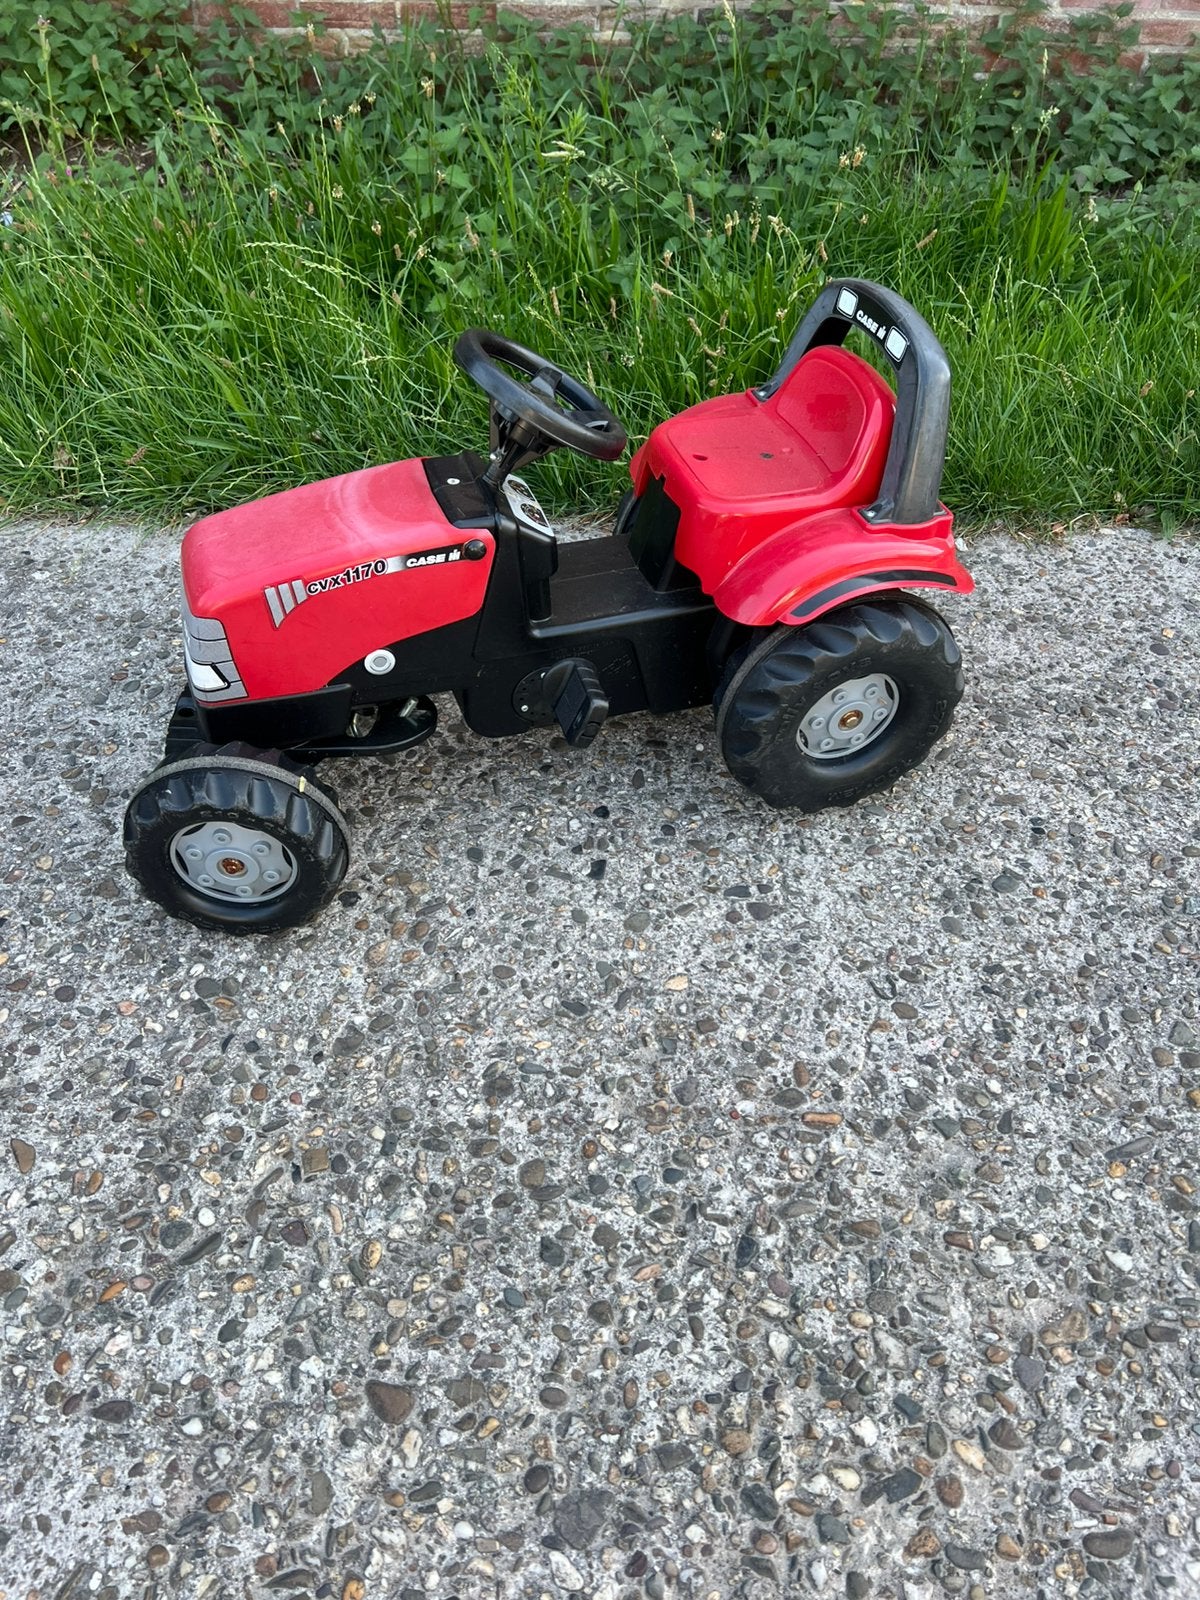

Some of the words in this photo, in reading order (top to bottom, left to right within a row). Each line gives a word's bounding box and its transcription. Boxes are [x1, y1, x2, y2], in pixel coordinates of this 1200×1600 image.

[856, 310, 878, 333] CASE
[306, 559, 387, 596] CVX1170
[406, 553, 446, 568] CASE
